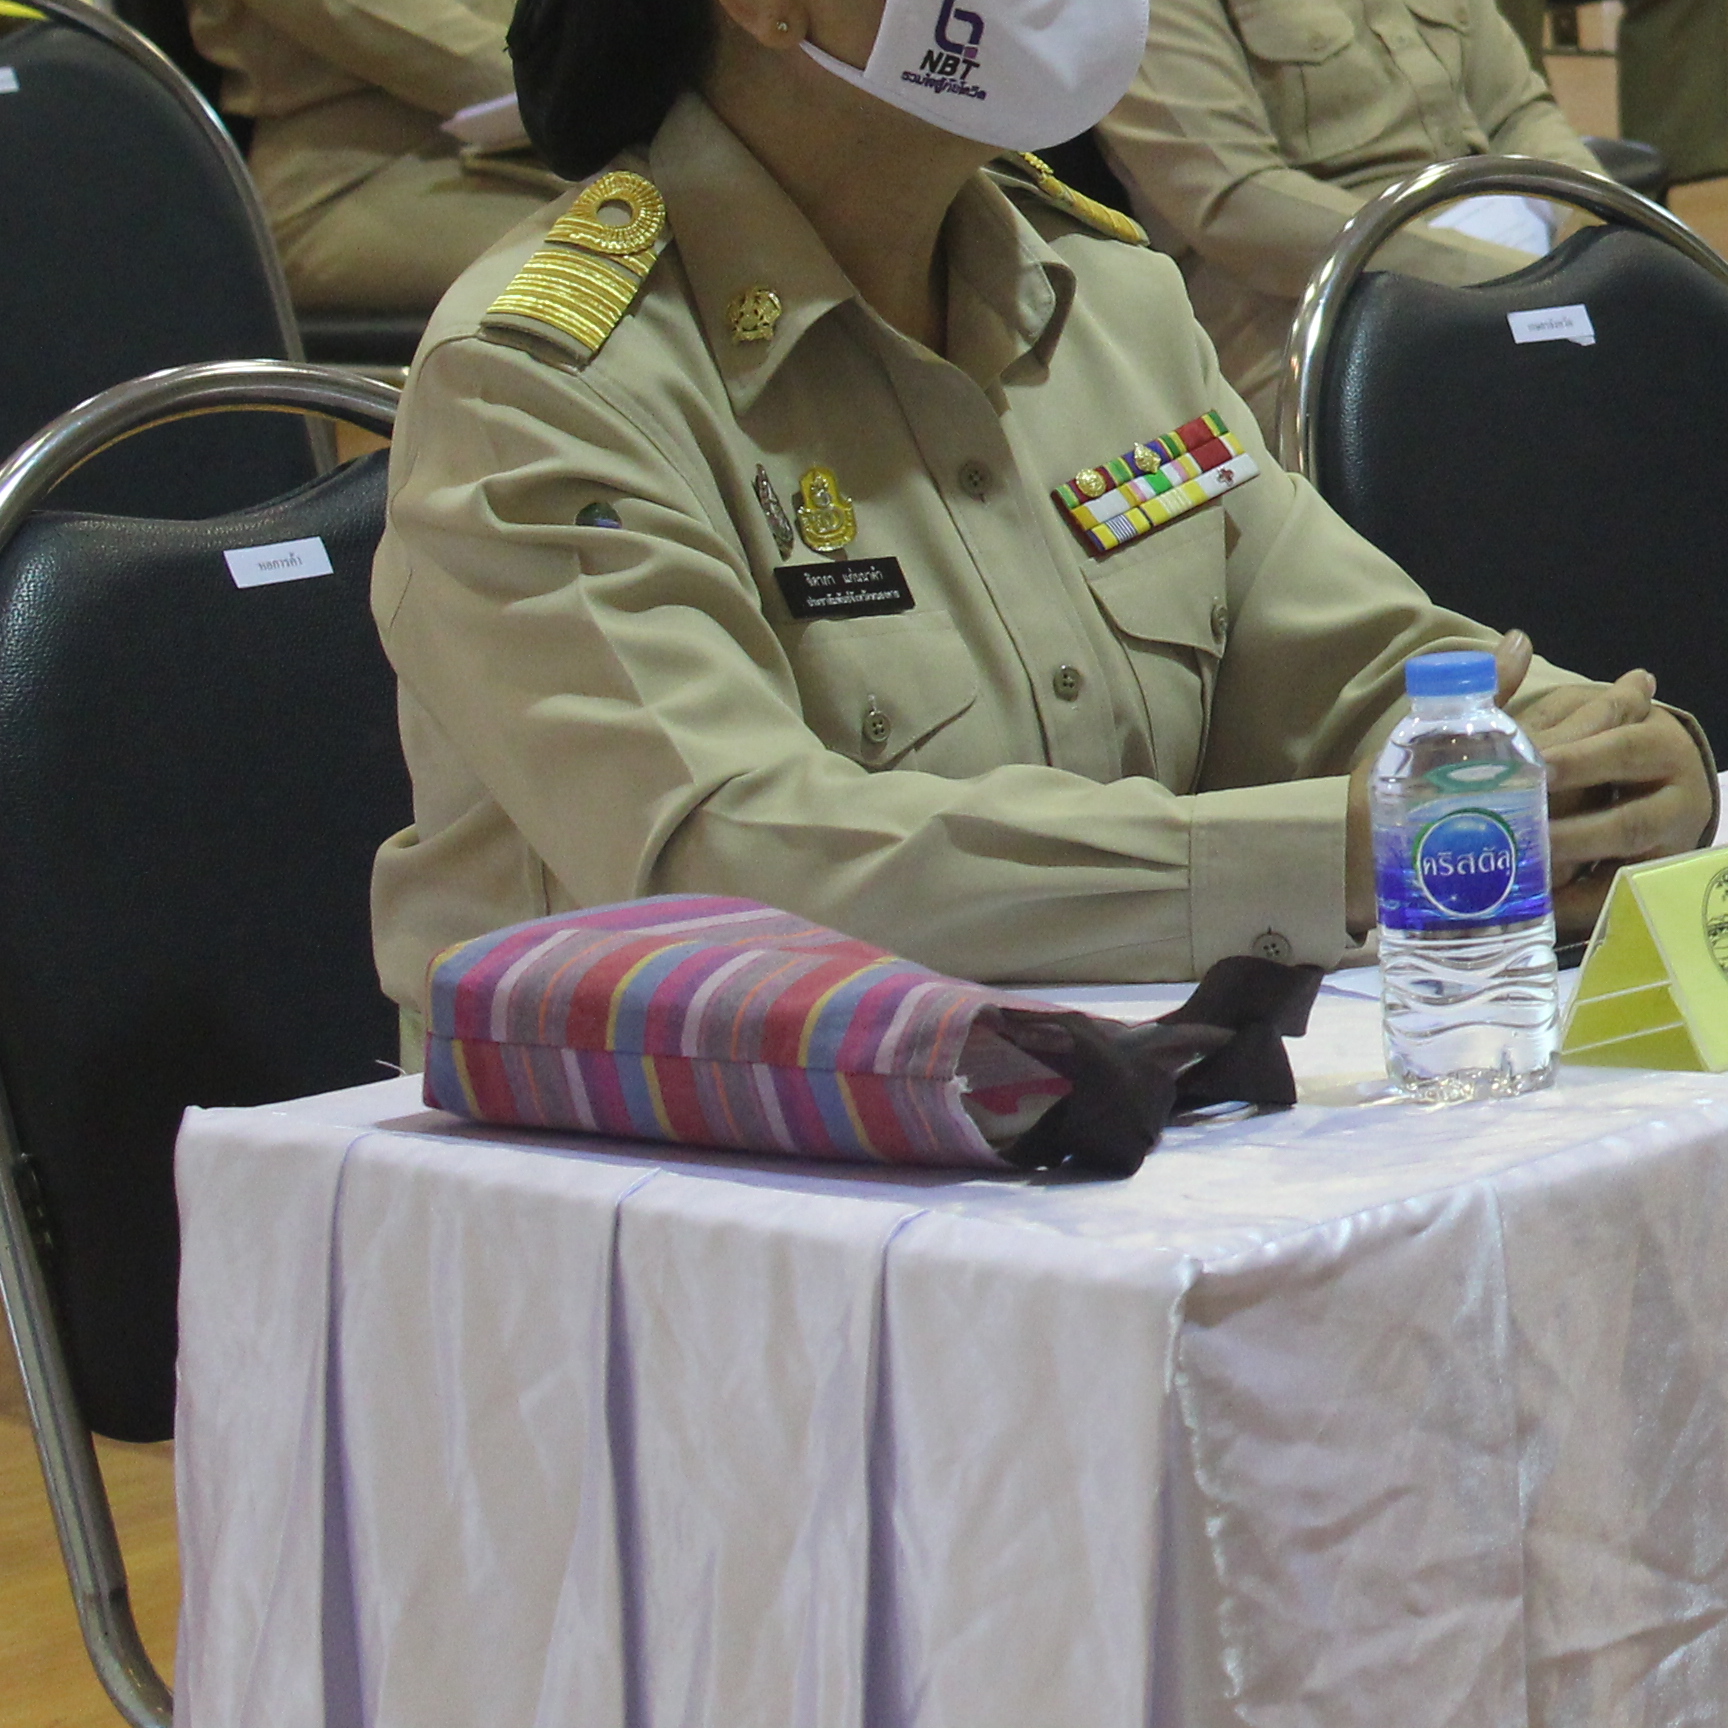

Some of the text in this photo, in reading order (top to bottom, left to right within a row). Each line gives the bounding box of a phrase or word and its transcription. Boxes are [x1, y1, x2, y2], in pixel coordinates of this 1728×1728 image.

[919, 49, 981, 80] NBT
[1422, 846, 1511, 876] คริสตัล
